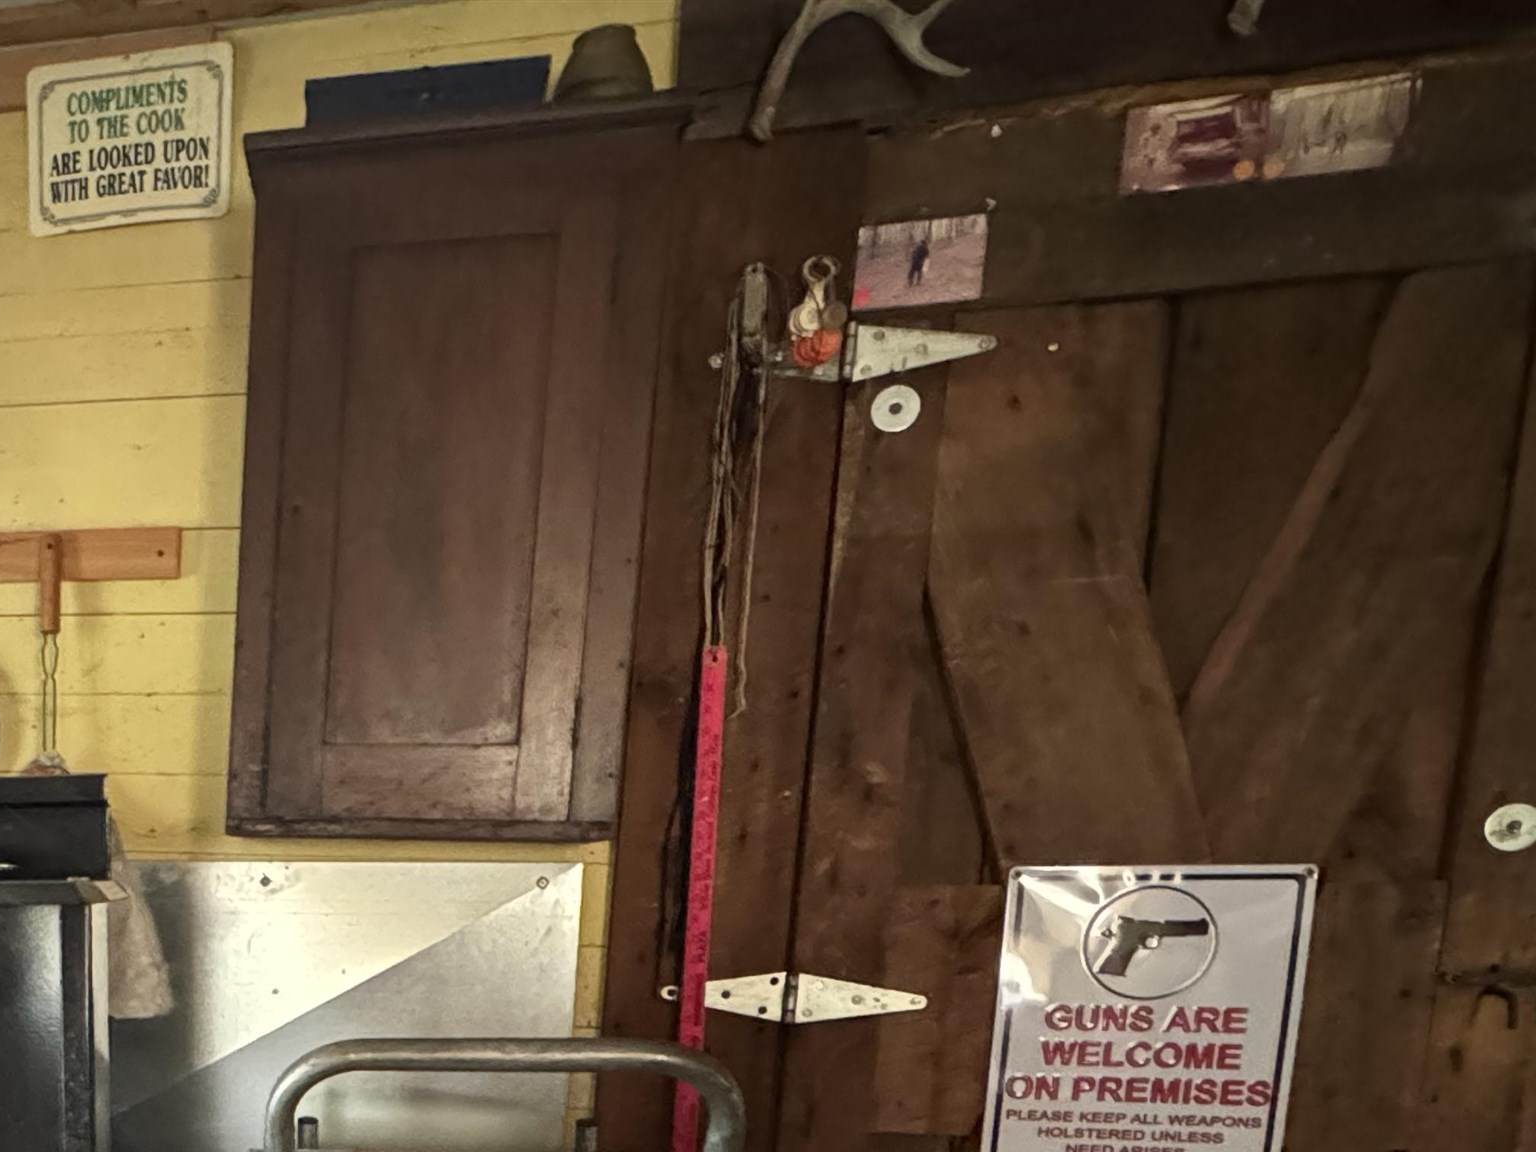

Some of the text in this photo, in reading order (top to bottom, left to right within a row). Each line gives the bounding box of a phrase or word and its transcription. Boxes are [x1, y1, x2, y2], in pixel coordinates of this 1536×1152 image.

[67, 79, 188, 116] COMPLIMENTS
[68, 108, 185, 144] TO THE COOK
[50, 137, 210, 176] ARE LOOKED UPON
[50, 165, 209, 204] WITH GREAT FAVOR!
[1044, 1004, 1248, 1034] GUNS ARE
[1040, 1038, 1243, 1070] WELCOME
[1005, 1075, 1272, 1107] ON PREMISES
[1006, 1109, 1261, 1128] PLEASE KEEP ALL WEAPONS
[1037, 1127, 1224, 1143] HOLSTERED UNLESS
